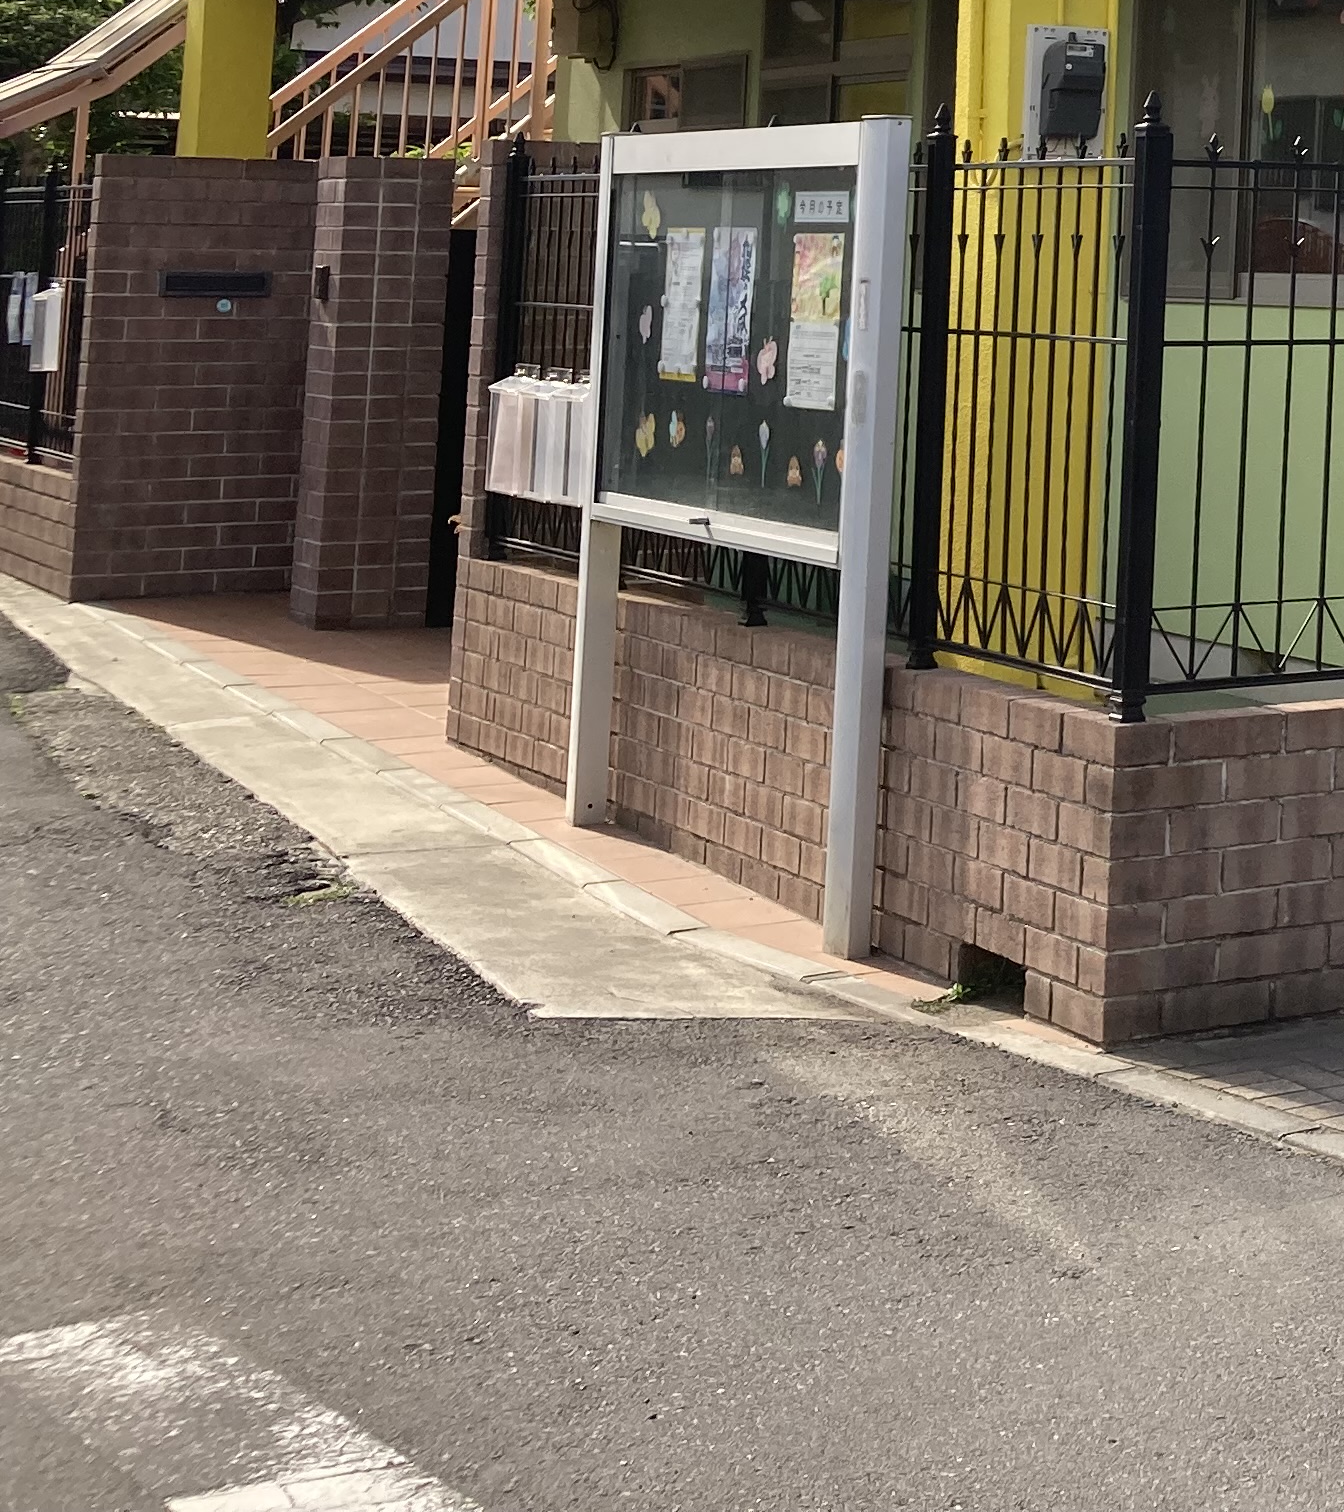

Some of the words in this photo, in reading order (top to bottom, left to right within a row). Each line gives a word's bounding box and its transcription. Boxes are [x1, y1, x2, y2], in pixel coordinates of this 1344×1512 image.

[799, 199, 844, 216] 今月の予定
